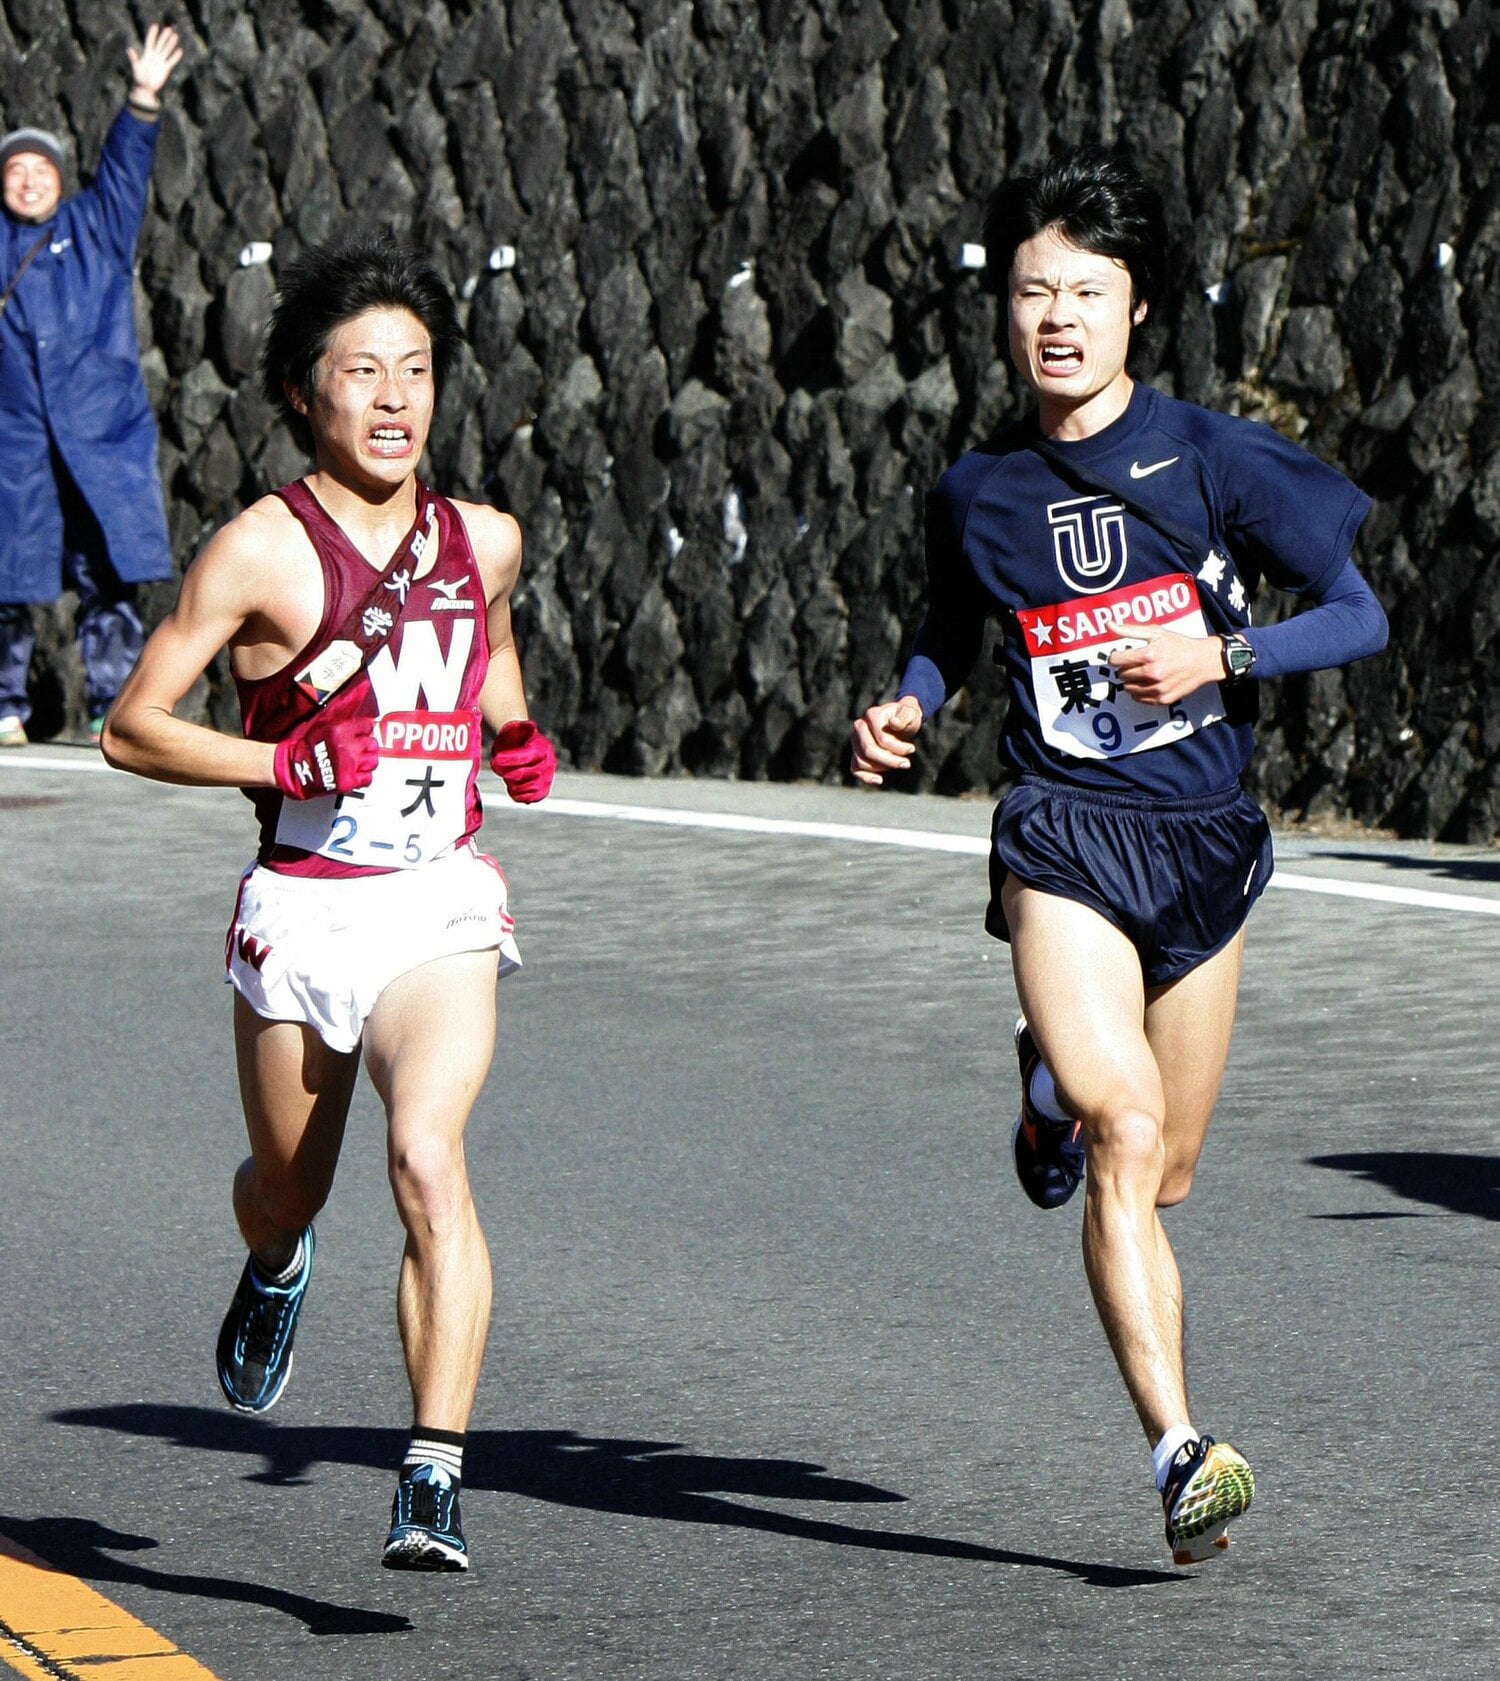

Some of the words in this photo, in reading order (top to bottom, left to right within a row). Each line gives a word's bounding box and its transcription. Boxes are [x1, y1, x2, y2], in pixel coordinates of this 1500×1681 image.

[1056, 582, 1191, 646] SAPPORO
[367, 618, 475, 713] W
[373, 721, 470, 752] APPORO
[237, 927, 274, 973] W
